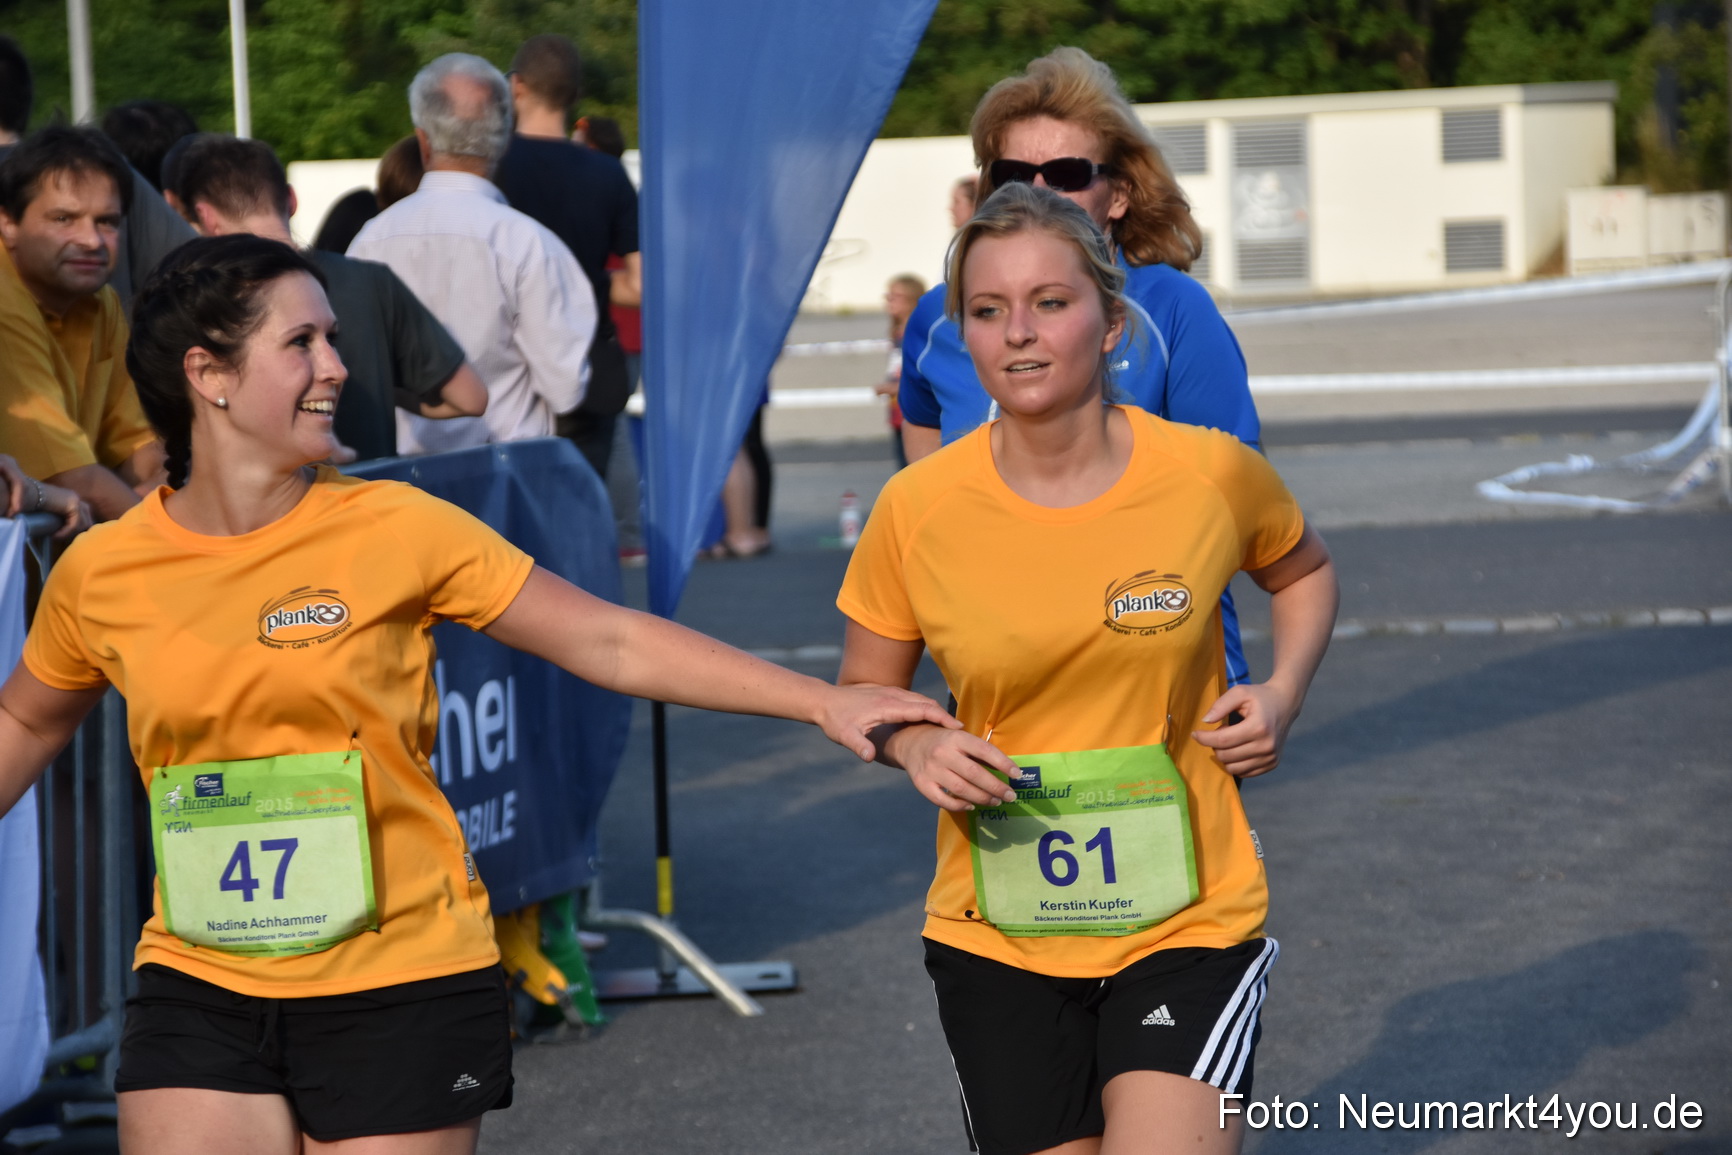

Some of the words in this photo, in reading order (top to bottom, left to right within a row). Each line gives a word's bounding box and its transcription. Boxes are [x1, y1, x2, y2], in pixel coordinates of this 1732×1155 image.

[1113, 590, 1168, 619] plank
[266, 604, 321, 634] plank
[183, 791, 252, 810] firmenlauf
[255, 797, 293, 812] 2015
[1076, 789, 1116, 804] 2015
[1038, 827, 1117, 887] 61
[219, 837, 299, 902] 47
[1040, 900, 1086, 911] Kerstin
[1089, 898, 1133, 911] Kupfer
[207, 919, 248, 932] Nadine
[250, 914, 328, 929] Achhammer
[298, 930, 320, 938] GmbH
[1142, 1018, 1175, 1026] adidas
